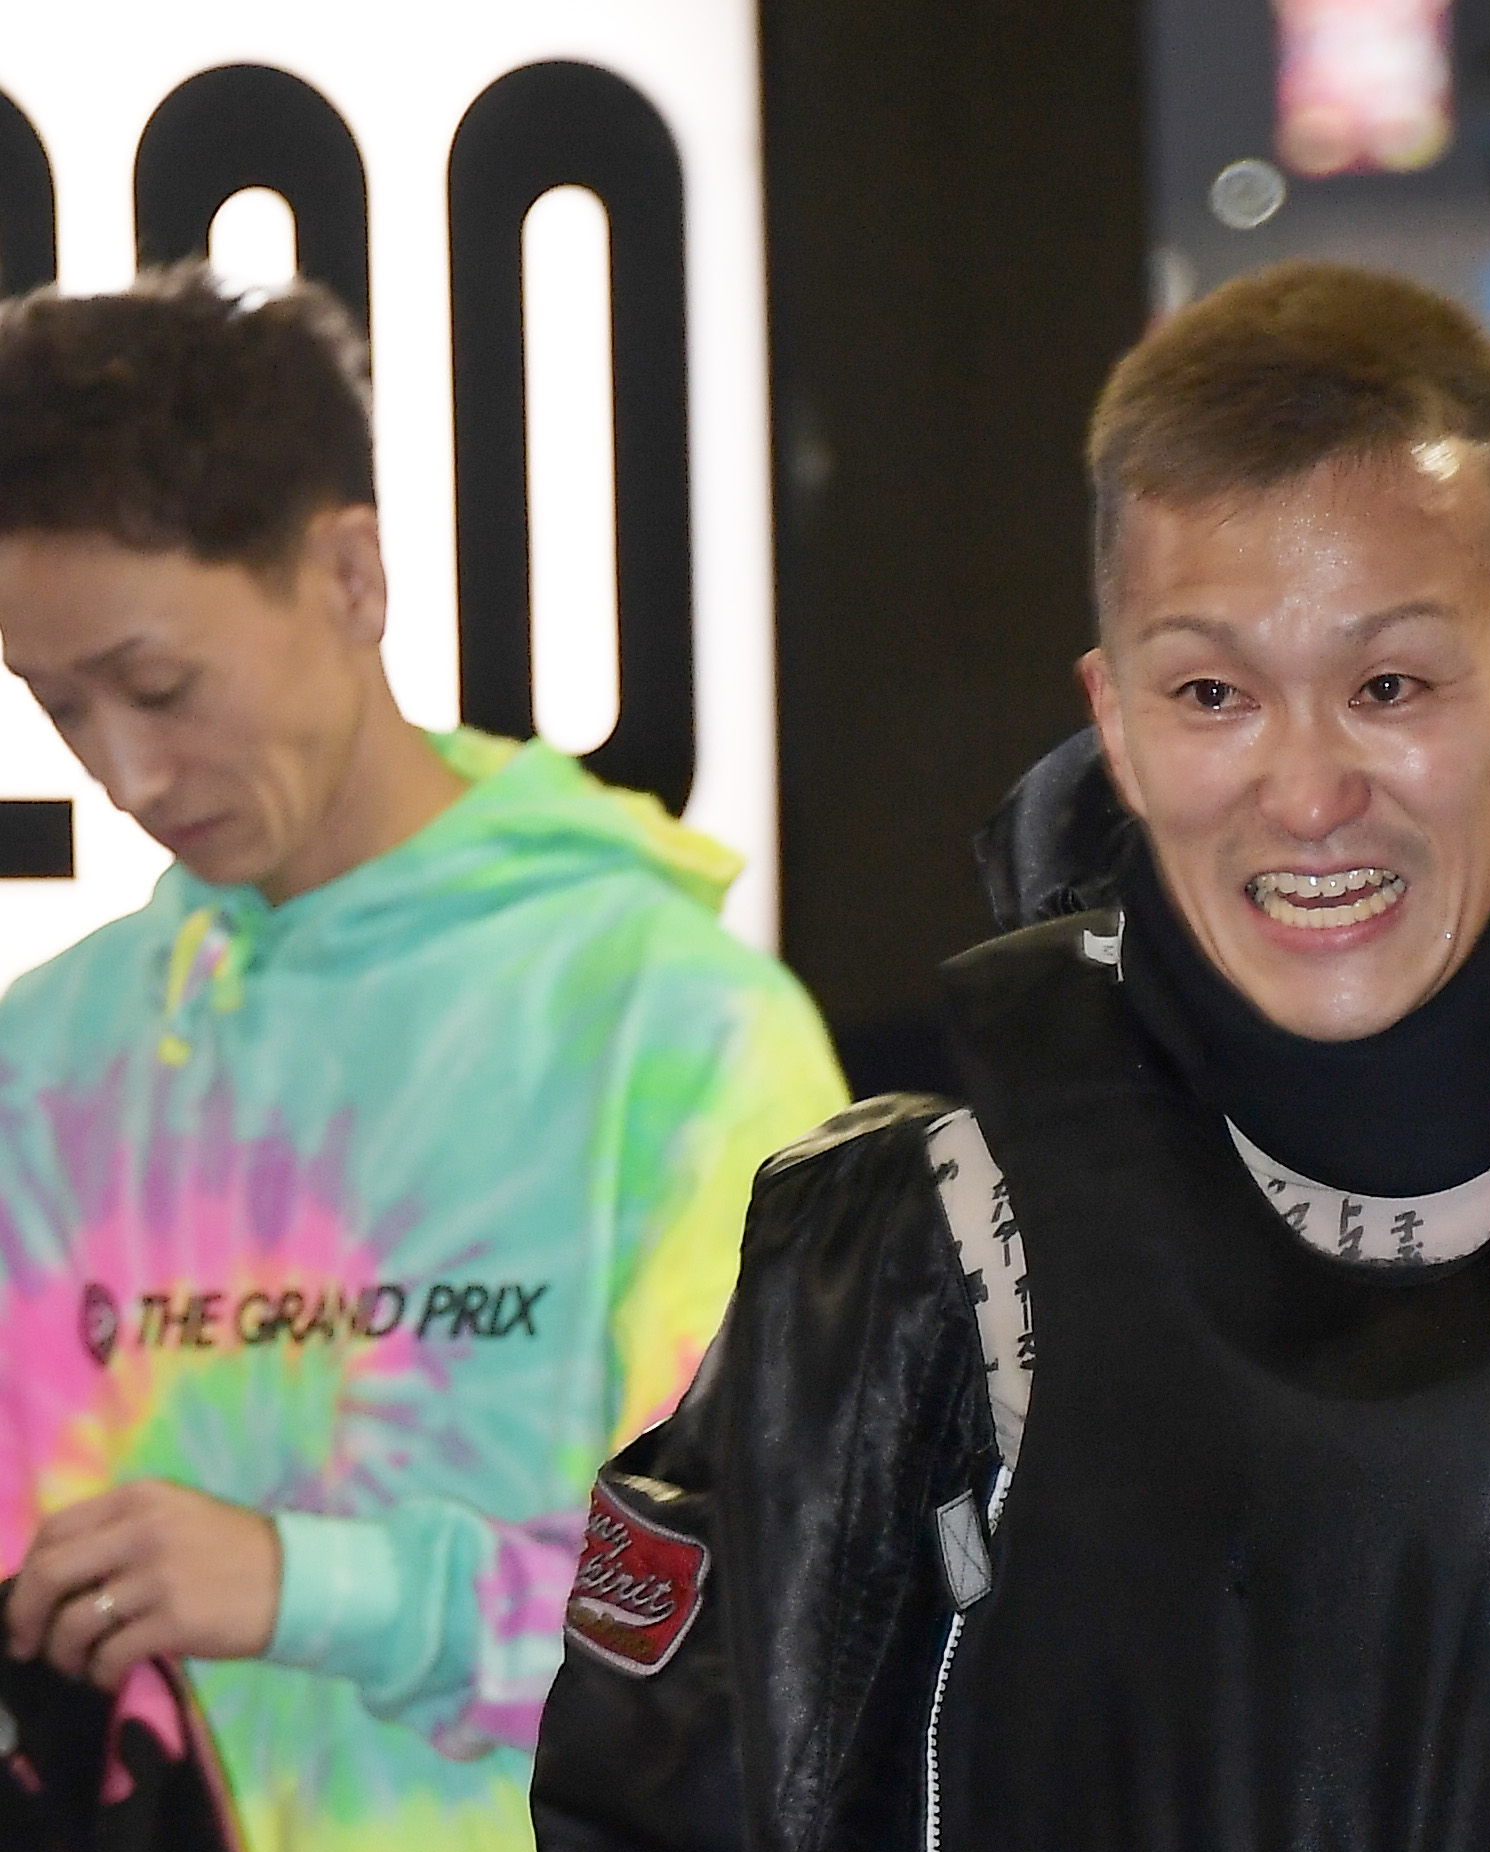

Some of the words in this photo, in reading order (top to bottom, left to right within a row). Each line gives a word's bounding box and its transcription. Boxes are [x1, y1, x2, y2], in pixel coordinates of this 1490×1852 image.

[137, 1291, 224, 1347] THE
[237, 1285, 407, 1344] GRAND
[415, 1281, 551, 1343] PRIX
